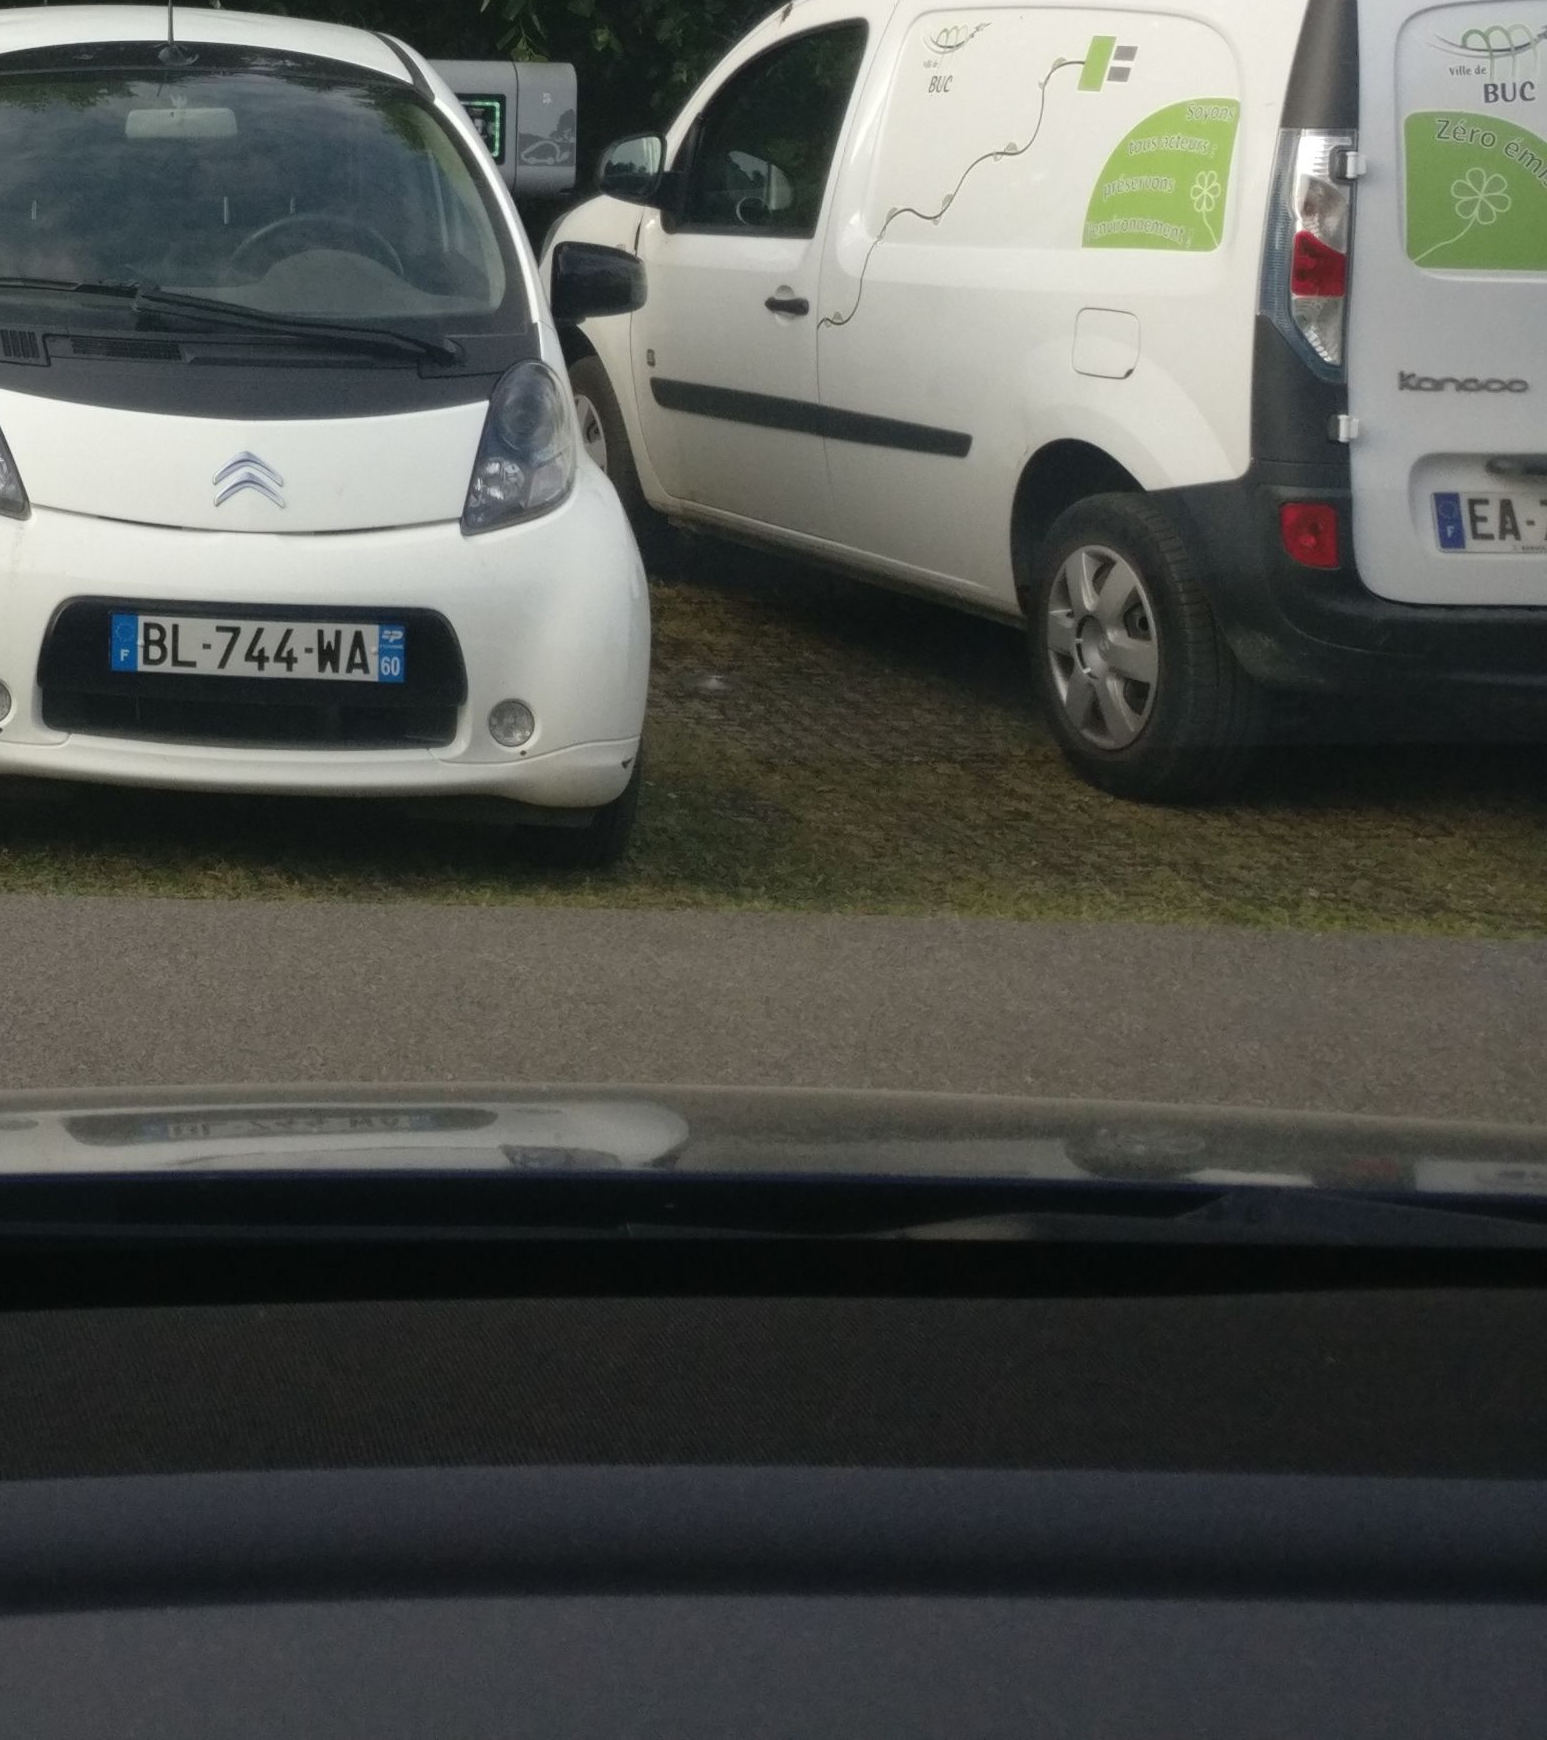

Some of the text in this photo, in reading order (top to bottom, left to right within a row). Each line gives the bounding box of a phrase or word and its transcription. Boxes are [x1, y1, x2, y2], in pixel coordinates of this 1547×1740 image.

[1448, 64, 1488, 77] Ville de
[927, 74, 953, 94] BUC
[1483, 80, 1536, 104] BUC
[1186, 102, 1236, 123] Soyons
[1436, 118, 1497, 148] Zéro
[1128, 136, 1157, 156] tous
[1446, 525, 1455, 539] F
[120, 622, 401, 676] F BL-744-WA 60
